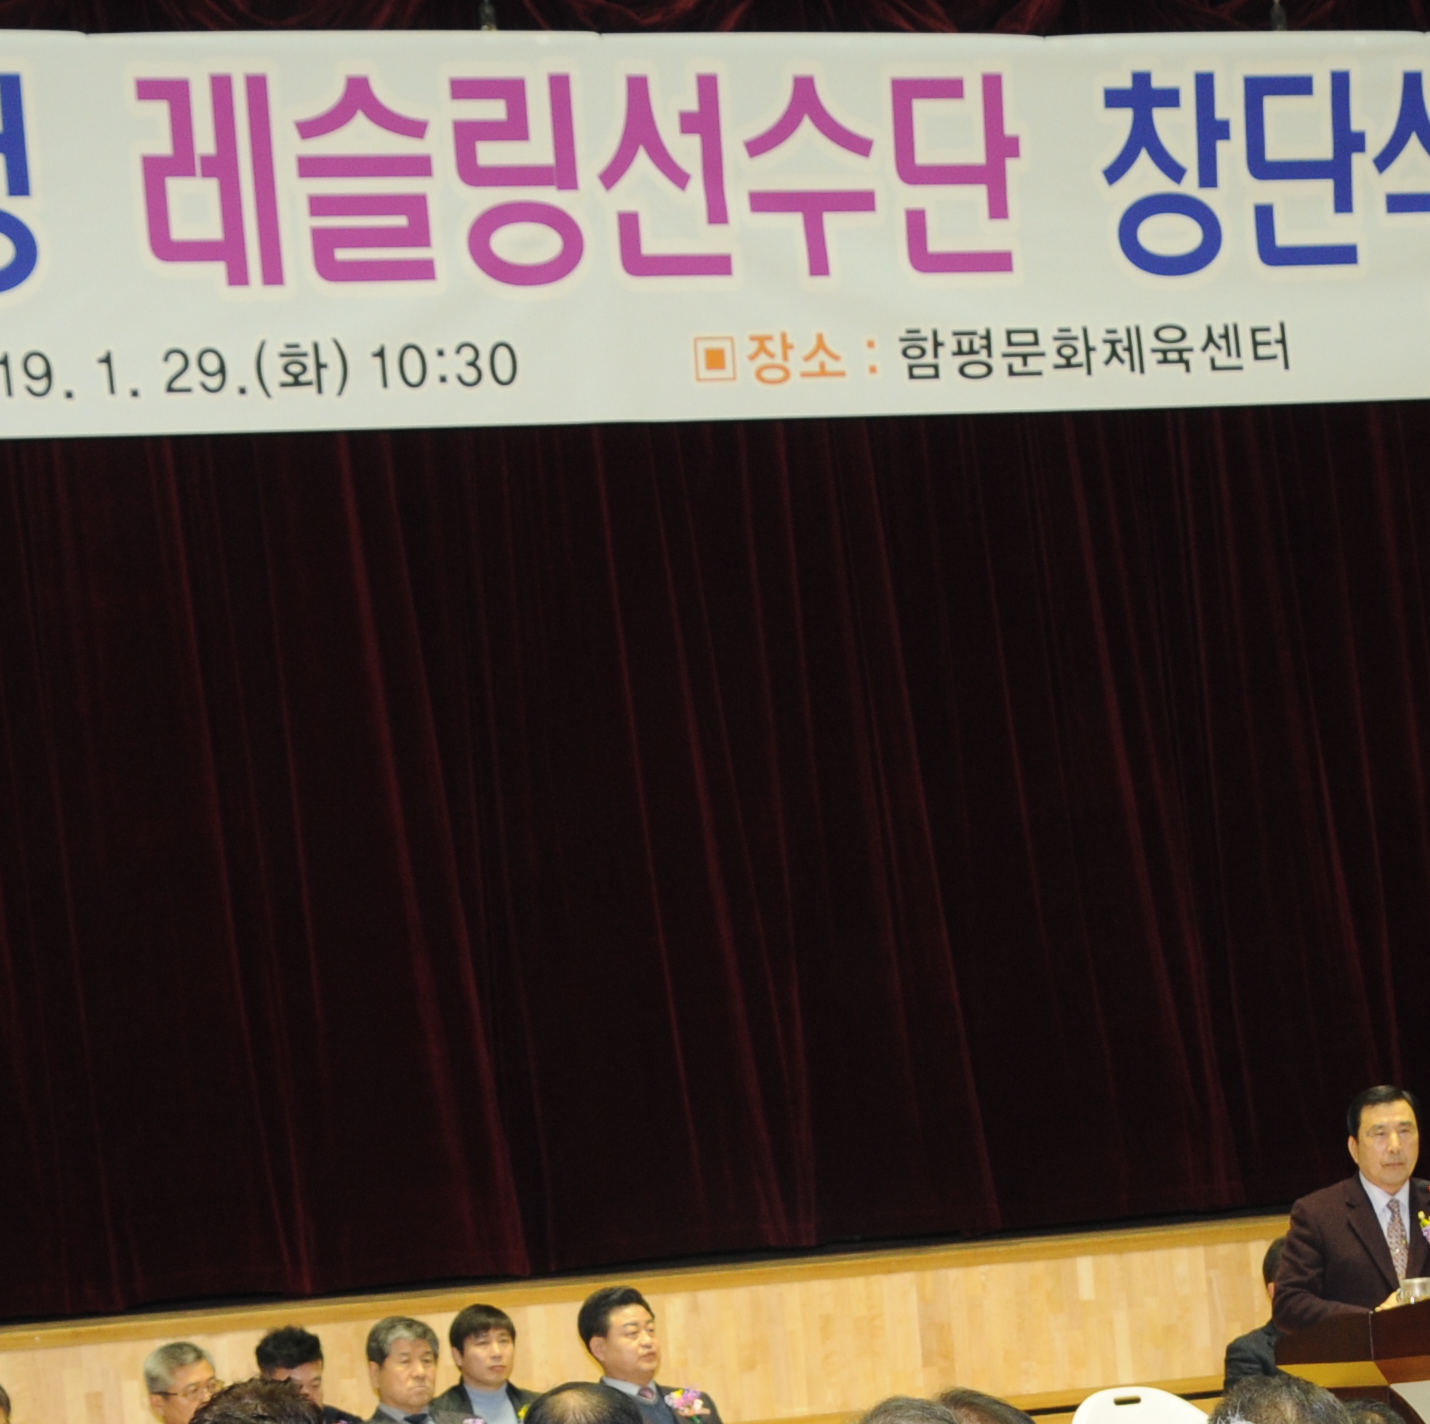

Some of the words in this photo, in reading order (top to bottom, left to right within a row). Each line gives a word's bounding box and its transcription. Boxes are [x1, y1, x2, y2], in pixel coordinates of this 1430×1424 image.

[133, 71, 1022, 288] 레슬링선수단
[370, 340, 519, 390] 10:30
[897, 320, 1291, 381] 함평문화체육센터
